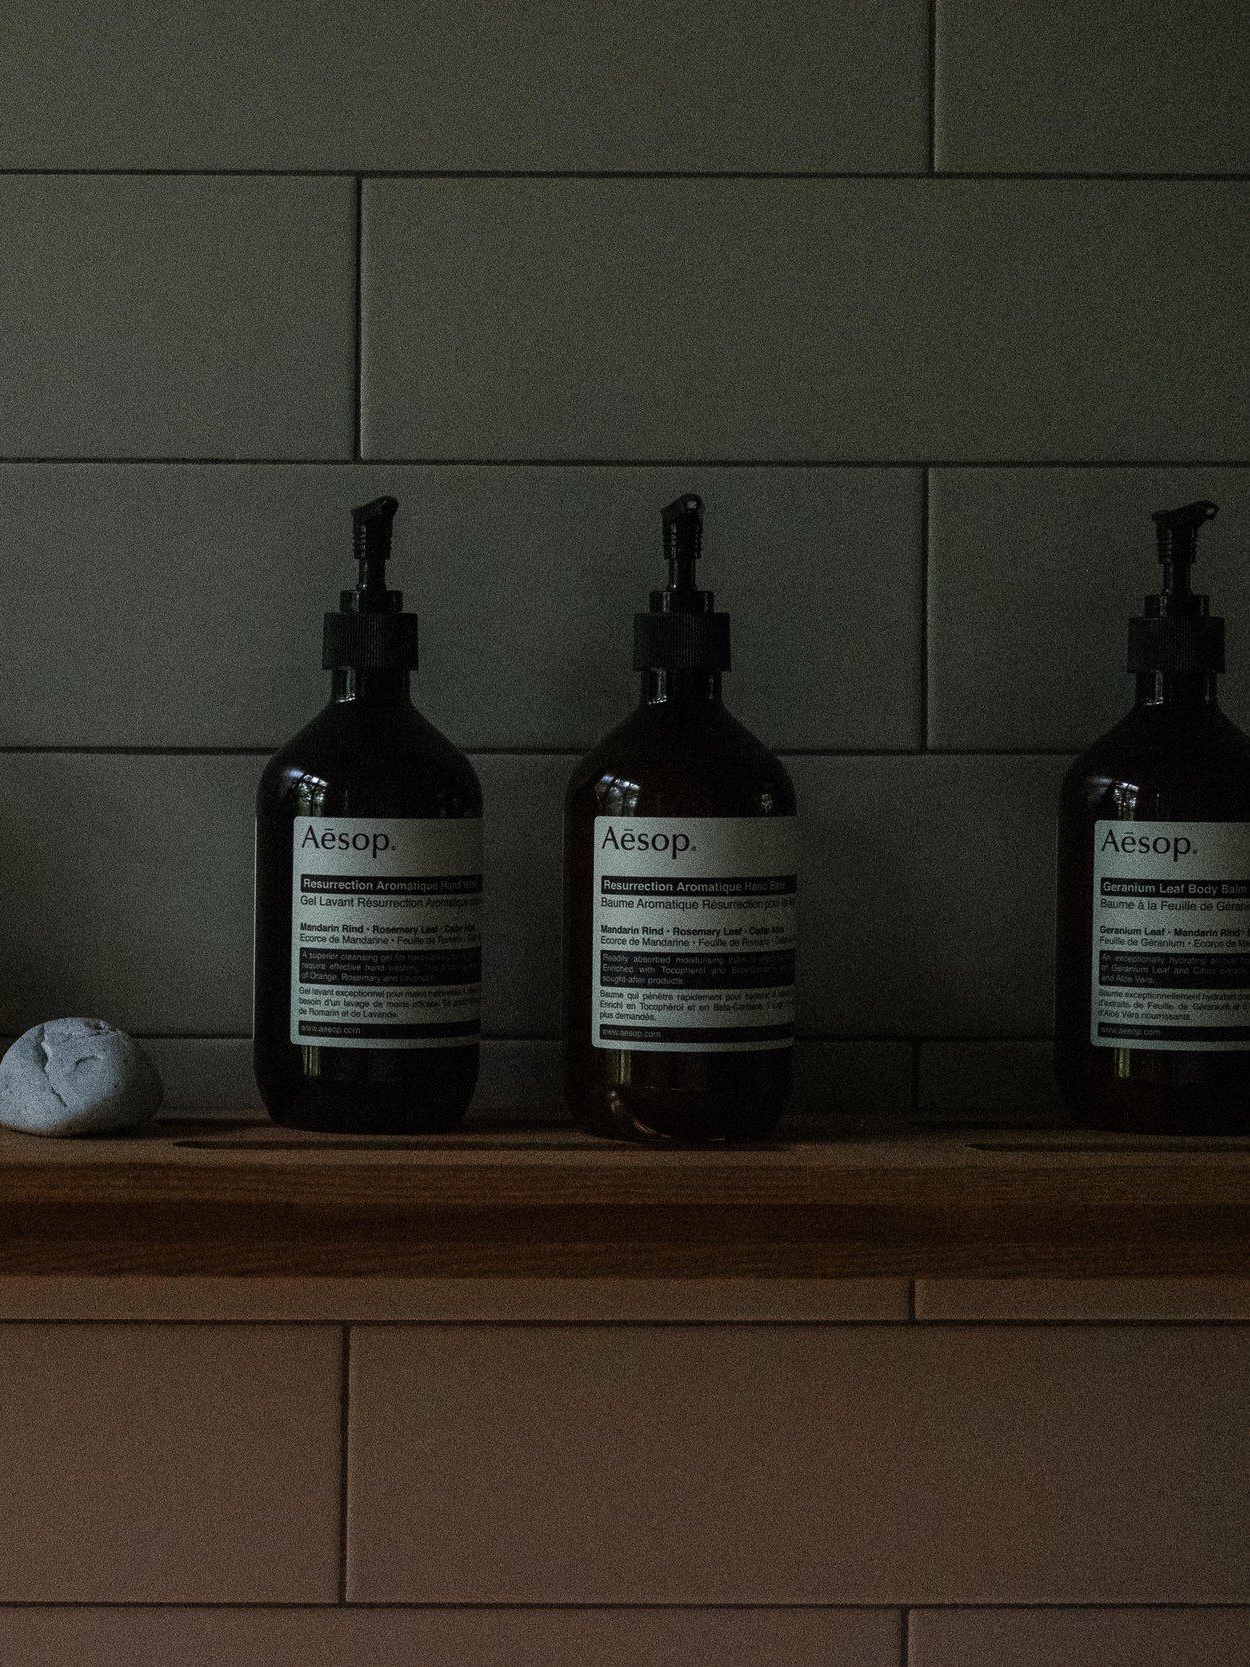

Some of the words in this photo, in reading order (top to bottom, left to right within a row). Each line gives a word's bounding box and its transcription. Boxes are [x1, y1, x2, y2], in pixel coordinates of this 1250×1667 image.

[303, 878, 373, 890] Resurrection
[377, 880, 438, 893] Aromatique
[603, 879, 674, 891] Resurrection
[676, 880, 742, 894] Aromatique
[744, 881, 768, 891] Hand
[1102, 881, 1156, 893] Geranium
[1159, 882, 1185, 894] Leaf
[1188, 883, 1218, 896] Body
[1221, 883, 1247, 894] Balm
[300, 894, 317, 906] Gel
[319, 895, 354, 907] Lavant
[357, 897, 423, 908] Résurrection
[600, 896, 635, 908] Baume
[636, 898, 699, 911] Aromatique
[702, 898, 763, 909] Résurrection
[1100, 898, 1135, 910] Baume
[1137, 899, 1145, 910] à
[1147, 899, 1157, 911] la
[1160, 900, 1197, 911] Feuille
[1199, 901, 1214, 911] de
[299, 921, 339, 932] Mandarin
[342, 924, 364, 933] Rind
[372, 925, 418, 935] Rosemary
[600, 924, 640, 934] Mandarin
[641, 926, 664, 935] Rind
[672, 926, 721, 937] Rosemary
[723, 926, 743, 936] Leaf
[1099, 925, 1142, 935] Geranium
[1144, 926, 1165, 936] Leaf
[1174, 927, 1218, 937] Mandarin
[1221, 928, 1240, 937] Rind
[299, 933, 327, 942] Ecorce
[329, 935, 340, 943] de
[342, 935, 389, 945] Mandarine
[600, 935, 627, 945] Ecorce
[628, 936, 640, 946] de
[642, 937, 690, 947] Mandarine
[698, 938, 727, 947] Feuille
[1100, 935, 1125, 945] Feuille
[1127, 937, 1138, 946] de
[1141, 937, 1185, 947] Géranium
[1194, 938, 1224, 948] Ecorce
[340, 953, 378, 963] cleansing
[380, 953, 393, 963] gel
[602, 953, 629, 963] Readily
[633, 955, 671, 964] absorbed
[602, 963, 634, 973] Enriched
[341, 973, 380, 983] Rosemary
[298, 986, 311, 995] Gel
[312, 987, 334, 996] lavant
[335, 989, 385, 998] exceptionnel
[600, 989, 624, 999] Baume
[627, 991, 639, 1001] qui
[298, 997, 321, 1006] besoin
[343, 999, 370, 1009] lavage
[309, 1007, 340, 1017] Romarin
[599, 1010, 614, 1020] plus
[300, 1024, 361, 1035] www.aesop.com
[602, 1028, 662, 1039] www.aesop.com
